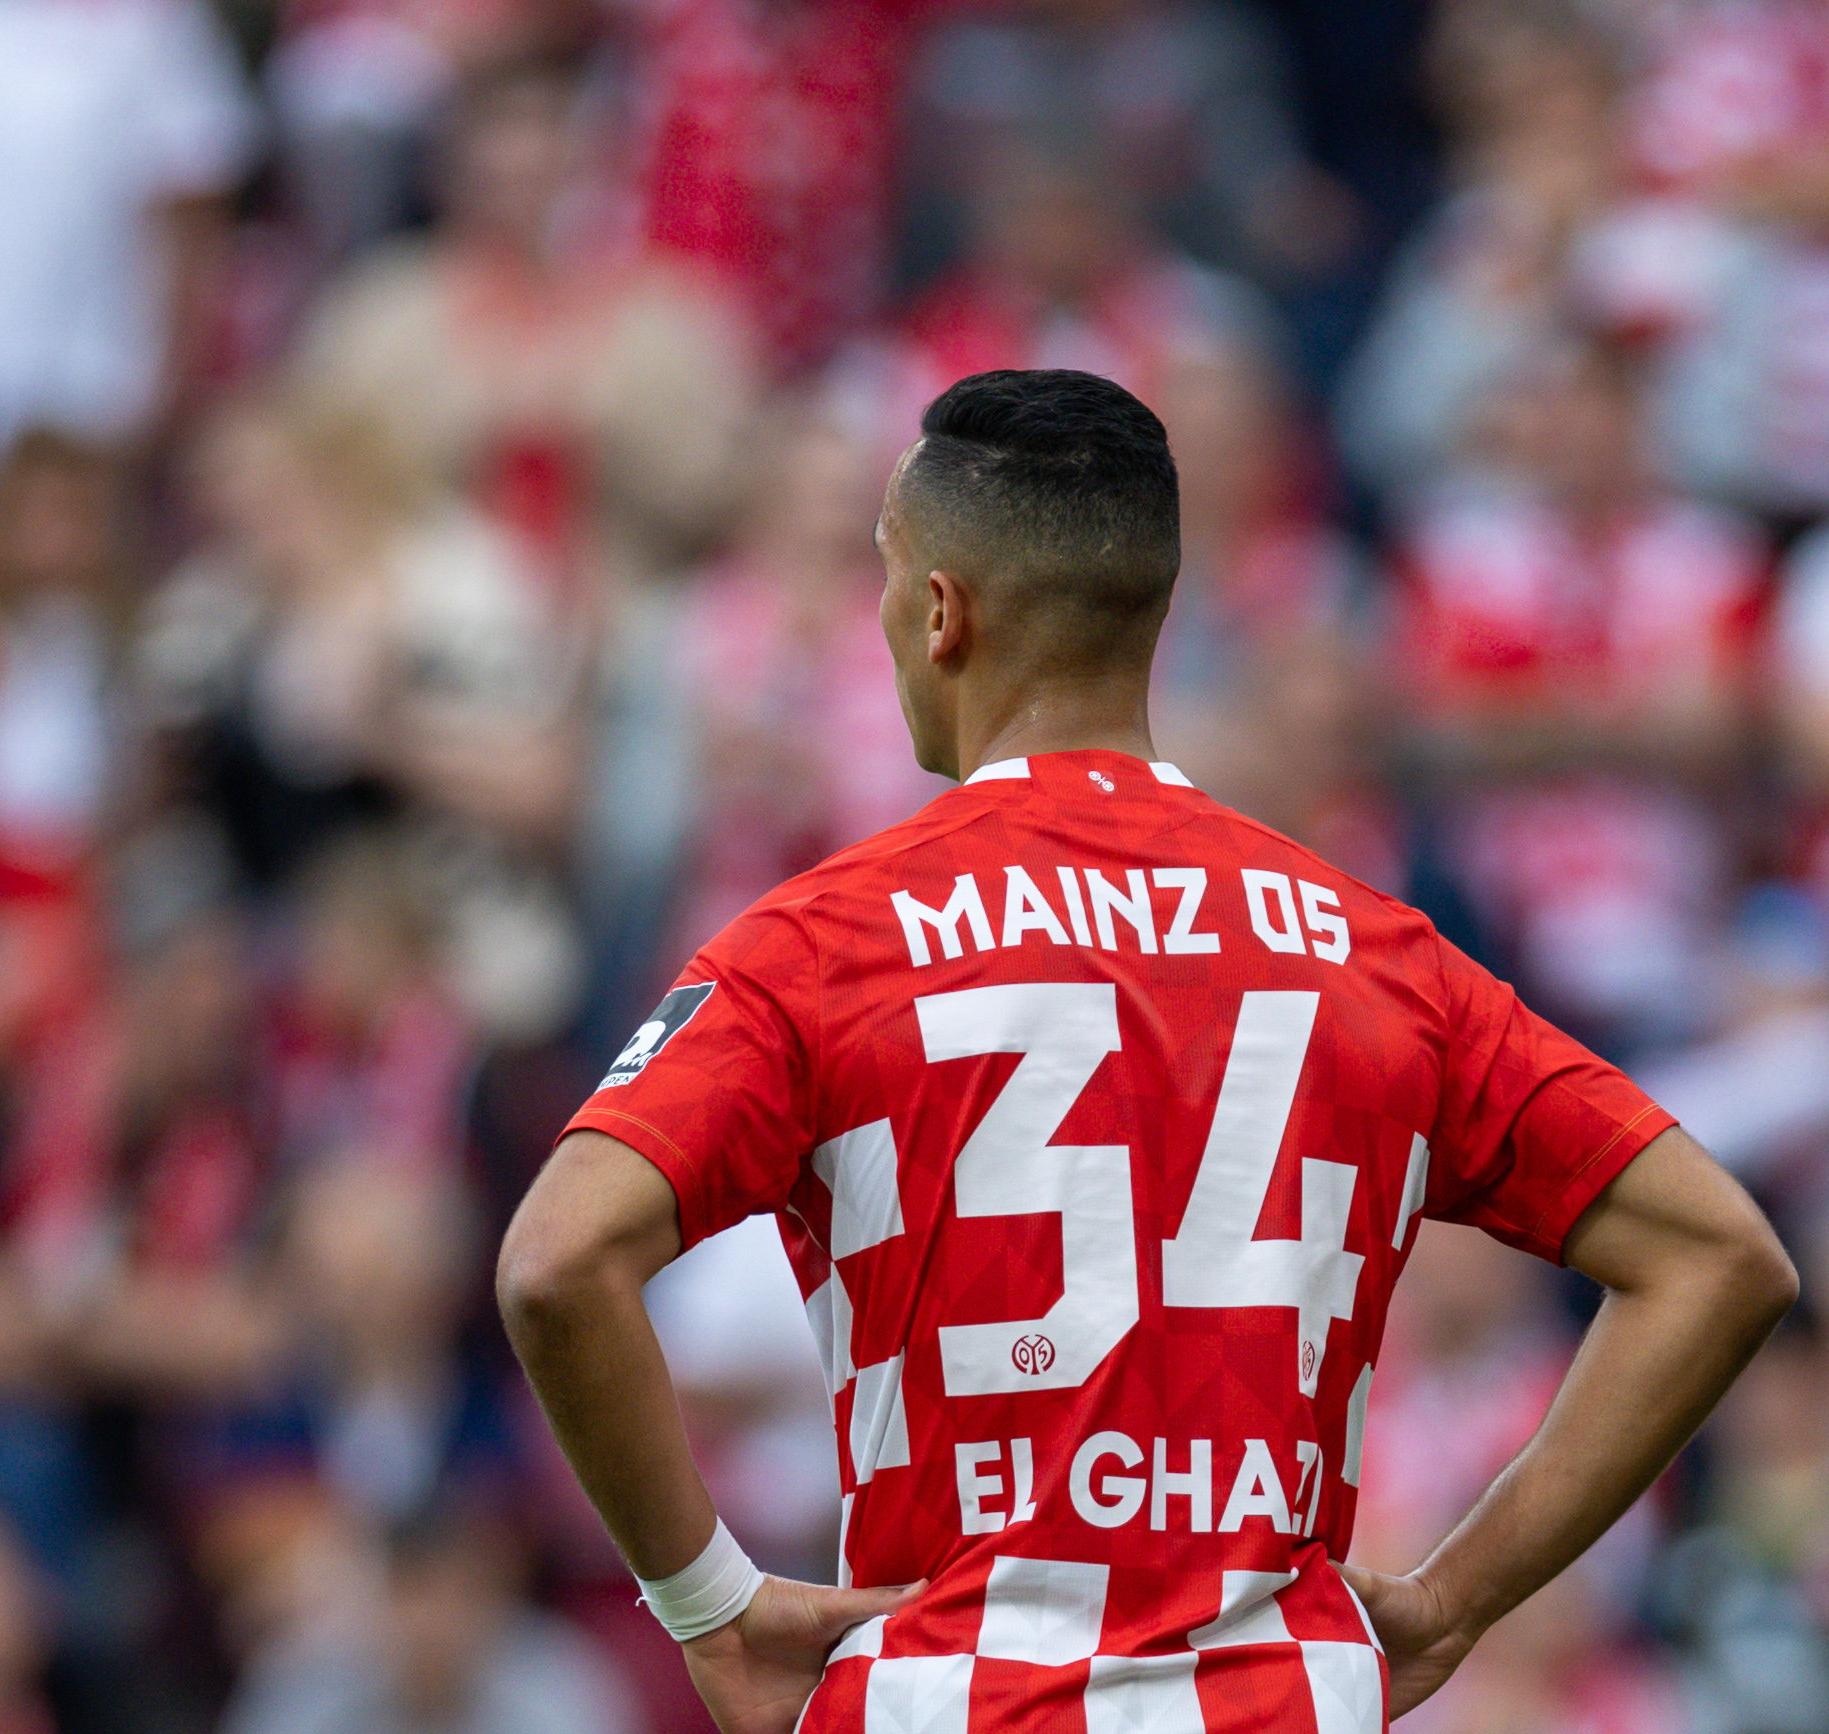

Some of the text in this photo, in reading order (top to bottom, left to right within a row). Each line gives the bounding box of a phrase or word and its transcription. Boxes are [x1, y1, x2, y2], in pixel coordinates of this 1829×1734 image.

[890, 866, 1351, 968] MAINZ 05
[914, 981, 1366, 1398] 34
[955, 1436, 1038, 1536] EL
